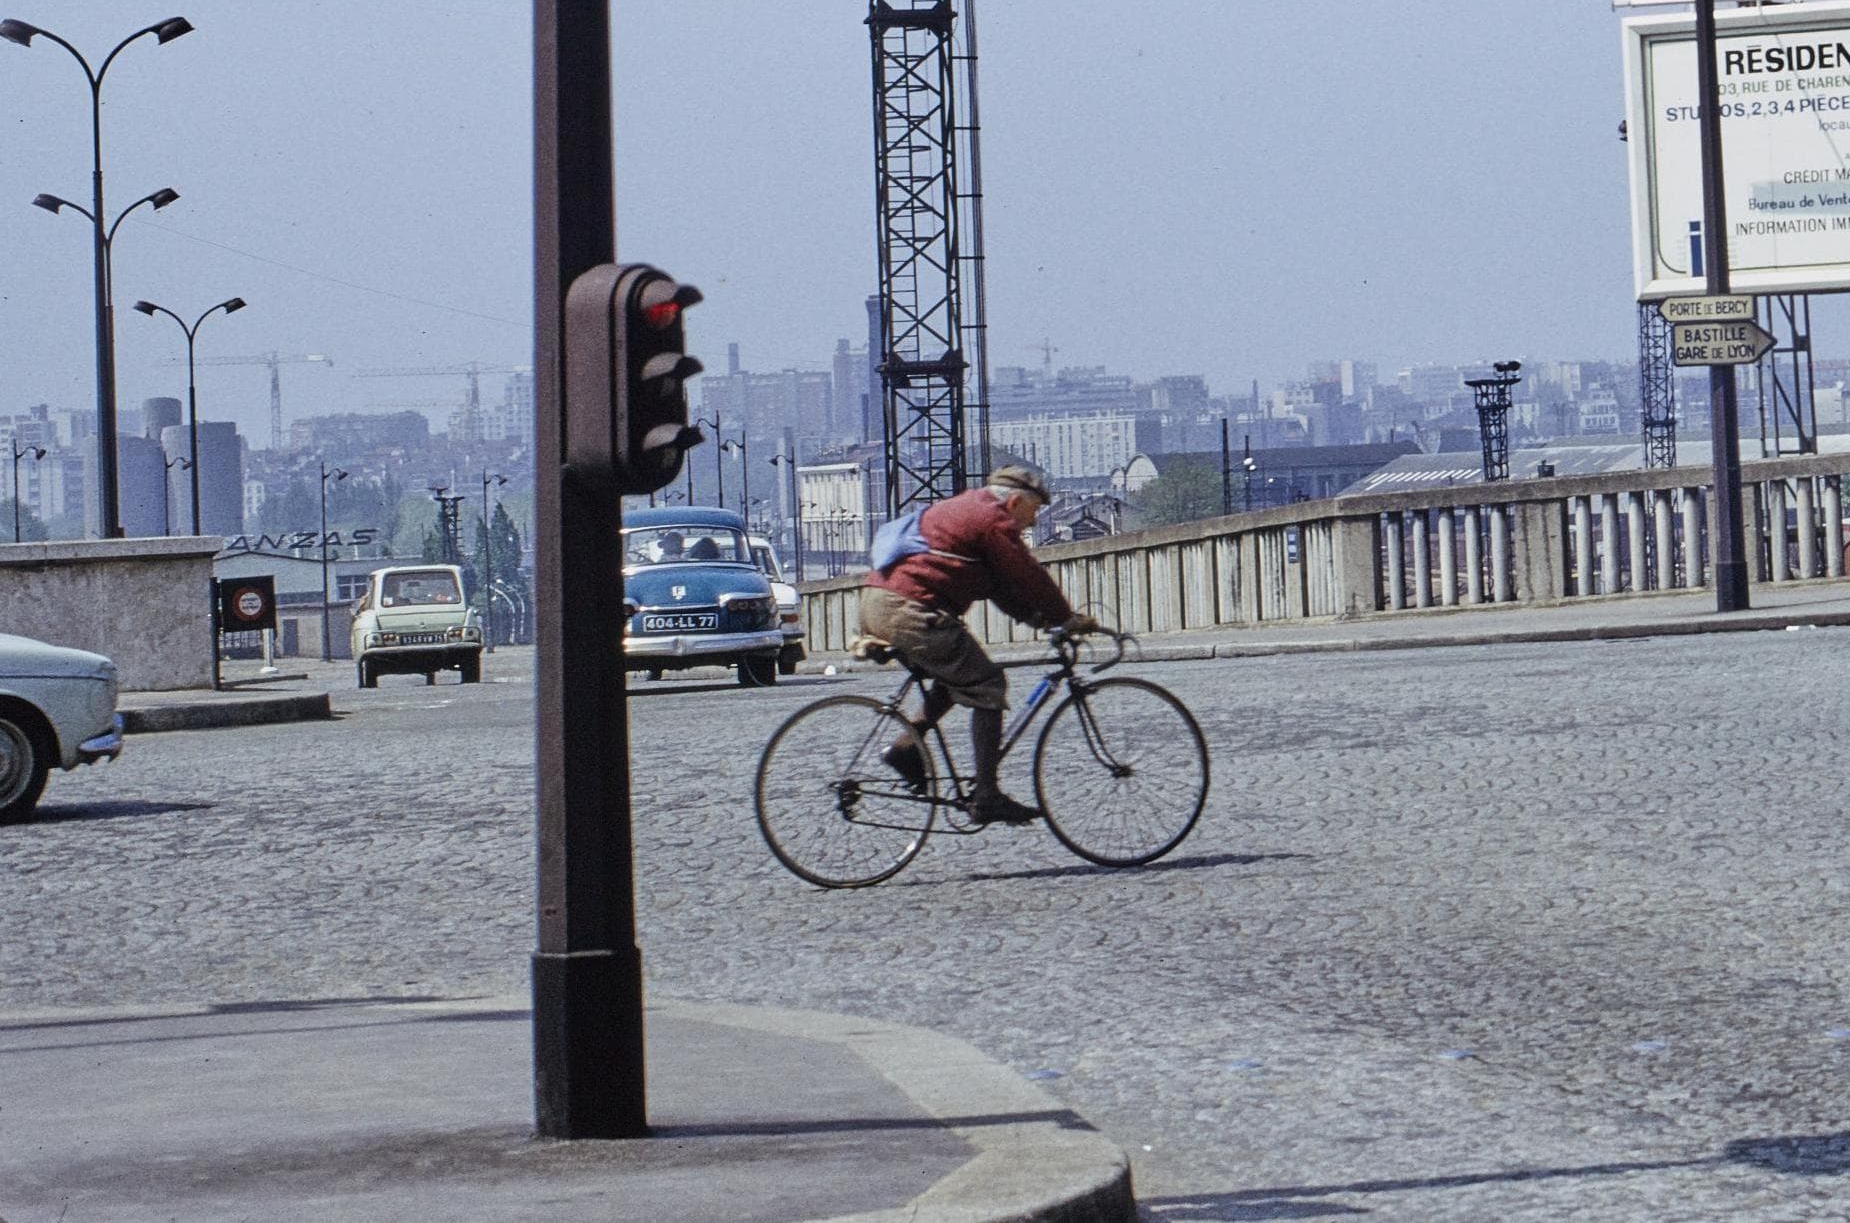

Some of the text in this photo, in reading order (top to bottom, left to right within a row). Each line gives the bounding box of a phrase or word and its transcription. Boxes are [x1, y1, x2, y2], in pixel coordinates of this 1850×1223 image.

[1775, 79, 1793, 92] DE
[1749, 197, 1795, 211] Bureau
[1800, 195, 1814, 207] de
[1736, 218, 1827, 236] INFORMATION
[1670, 302, 1701, 316] PORTE
[1716, 300, 1748, 315] BERCY
[1684, 327, 1747, 343] BASTILLE
[1676, 343, 1756, 360] GARE DE LYON
[698, 615, 715, 628] 77
